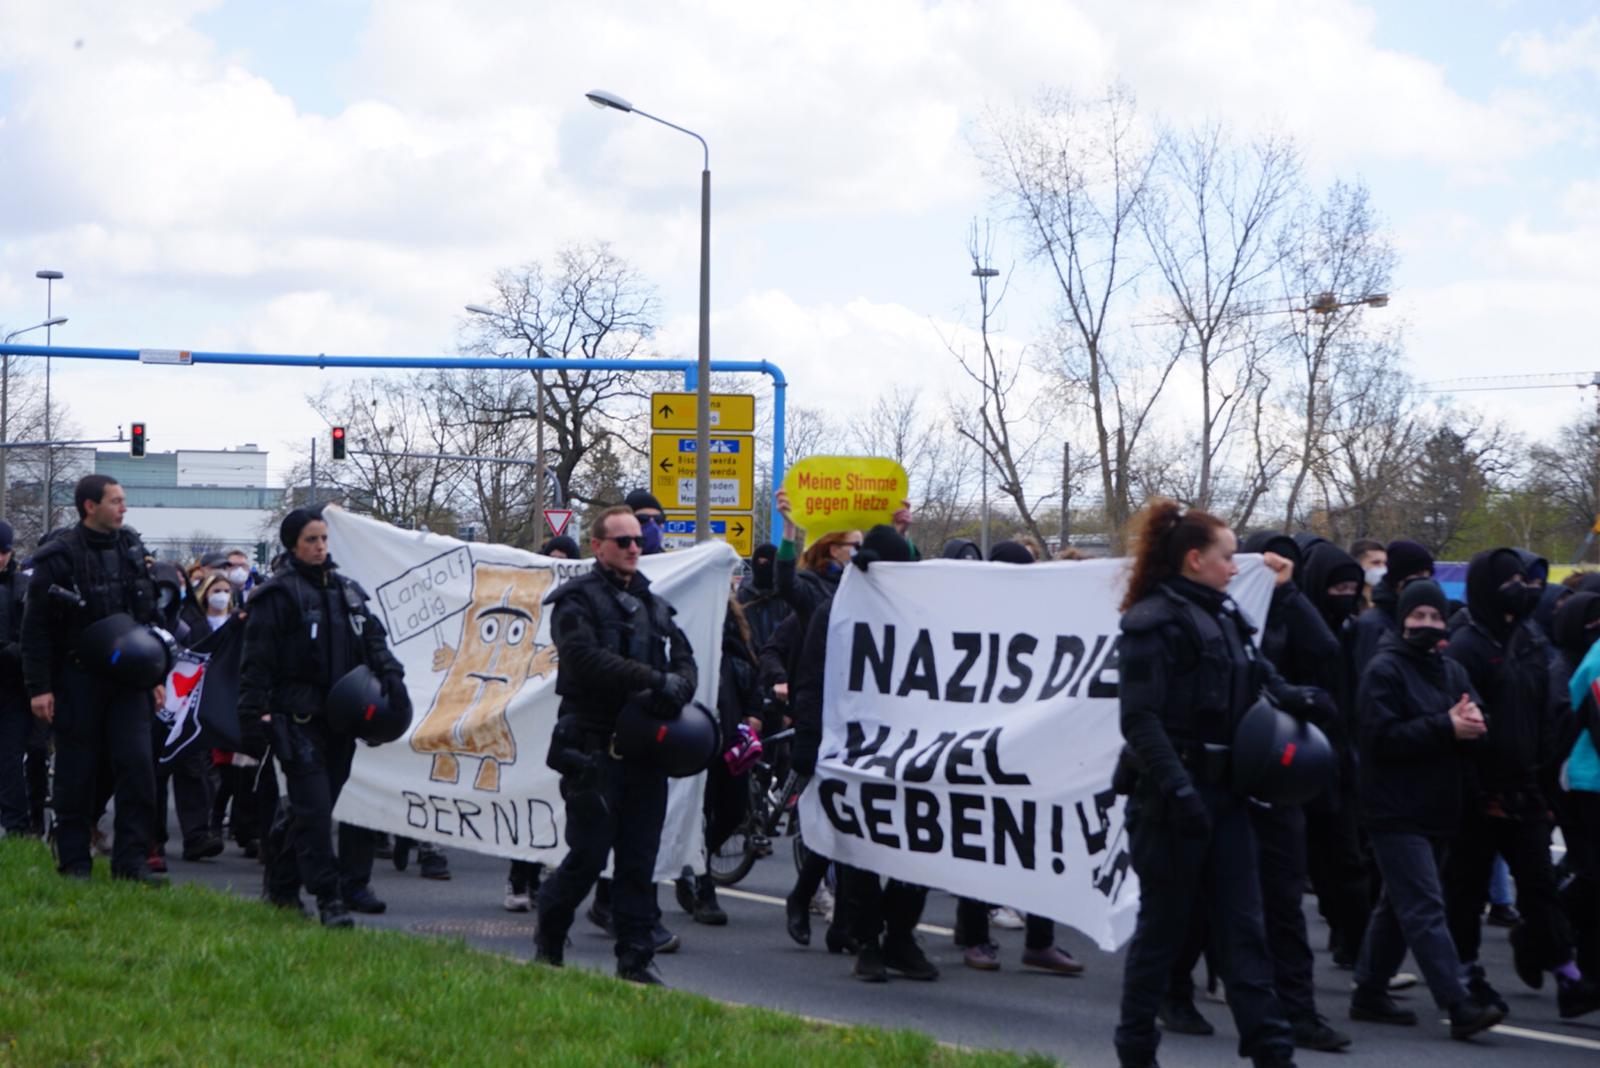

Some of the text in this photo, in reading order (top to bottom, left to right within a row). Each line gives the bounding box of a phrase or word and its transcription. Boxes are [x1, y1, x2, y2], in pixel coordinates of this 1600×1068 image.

[678, 456, 737, 465] Biscwerda
[798, 472, 897, 491] Meine Stimme
[806, 494, 889, 515] gegen Hetze
[383, 552, 465, 612] Landolf
[394, 596, 447, 637] Ladig
[849, 622, 1120, 703] NAZIS DIE
[402, 791, 559, 849] BERND
[819, 778, 1064, 875] GEBEN!
